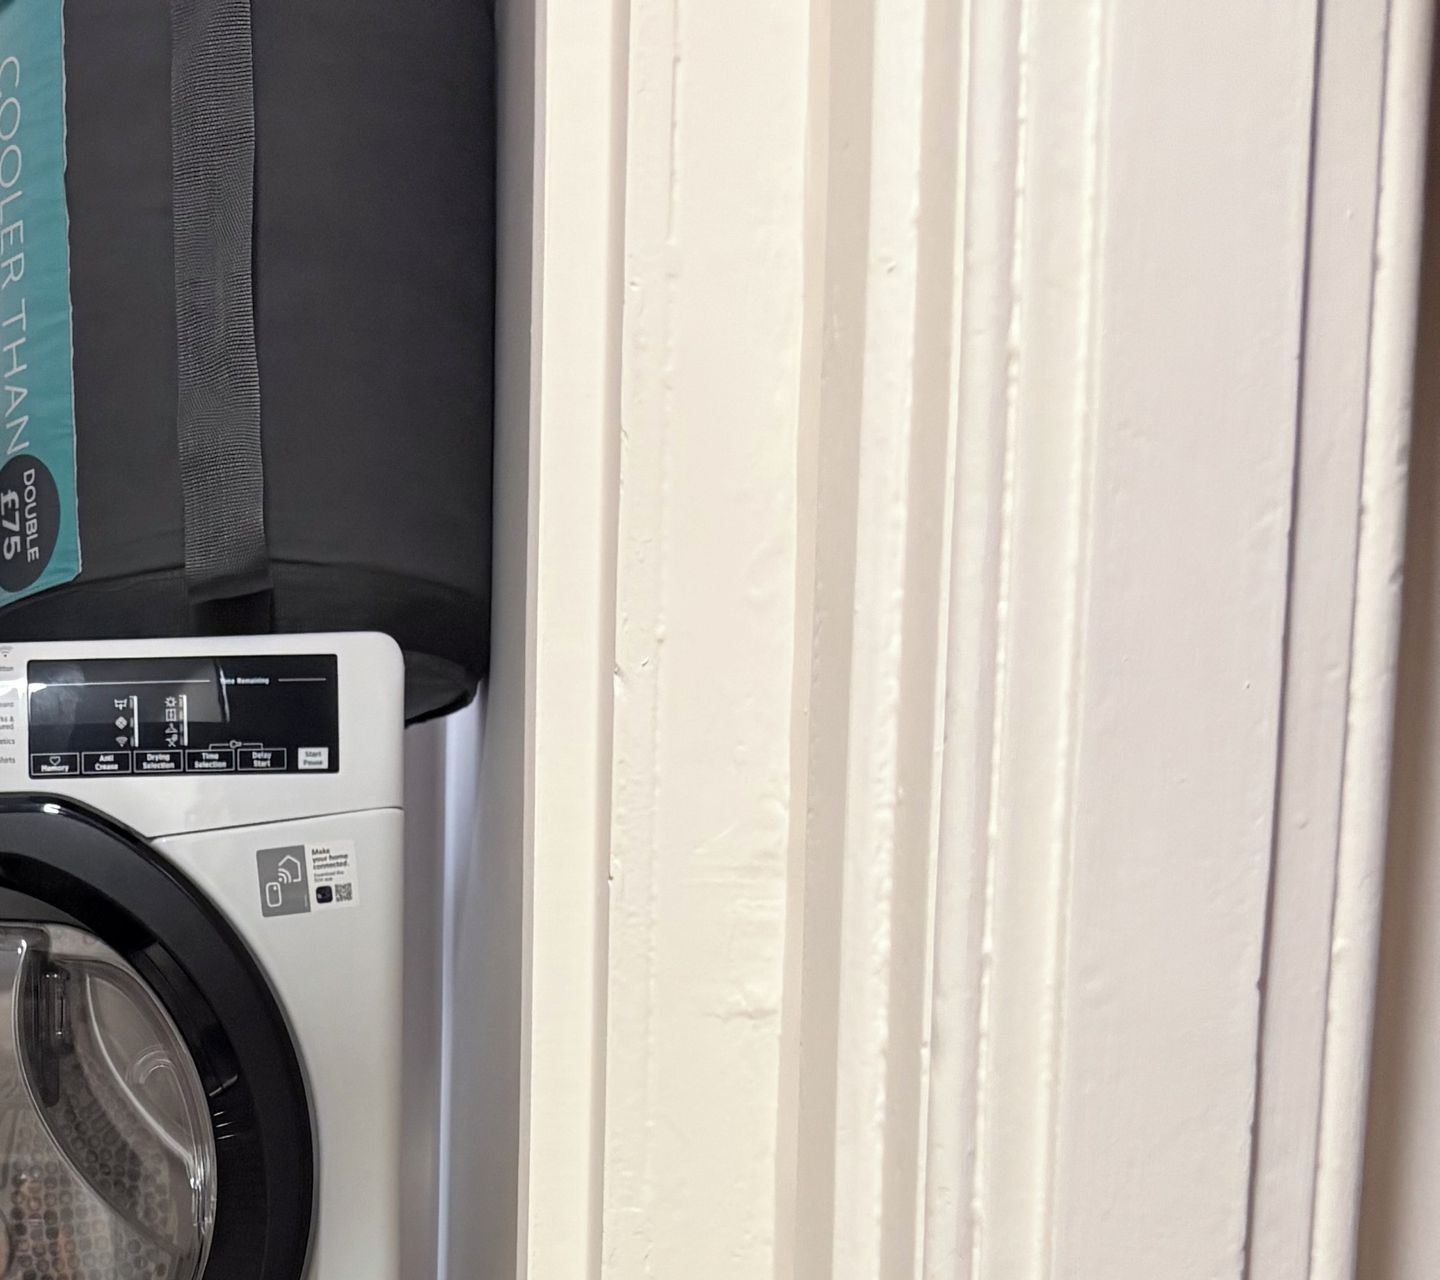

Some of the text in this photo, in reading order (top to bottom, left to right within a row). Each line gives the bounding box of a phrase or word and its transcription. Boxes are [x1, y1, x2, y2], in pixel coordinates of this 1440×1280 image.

[0, 298, 30, 456] THAN
[23, 468, 39, 563] DOUBLE
[0, 489, 21, 560] £75
[236, 677, 270, 685] Remaining
[147, 753, 170, 762] Drying
[252, 752, 272, 760] Delay
[143, 761, 175, 770] Selection
[194, 760, 227, 768] Selection
[253, 759, 271, 768] Start
[41, 764, 69, 773] Memory
[312, 856, 327, 864] your
